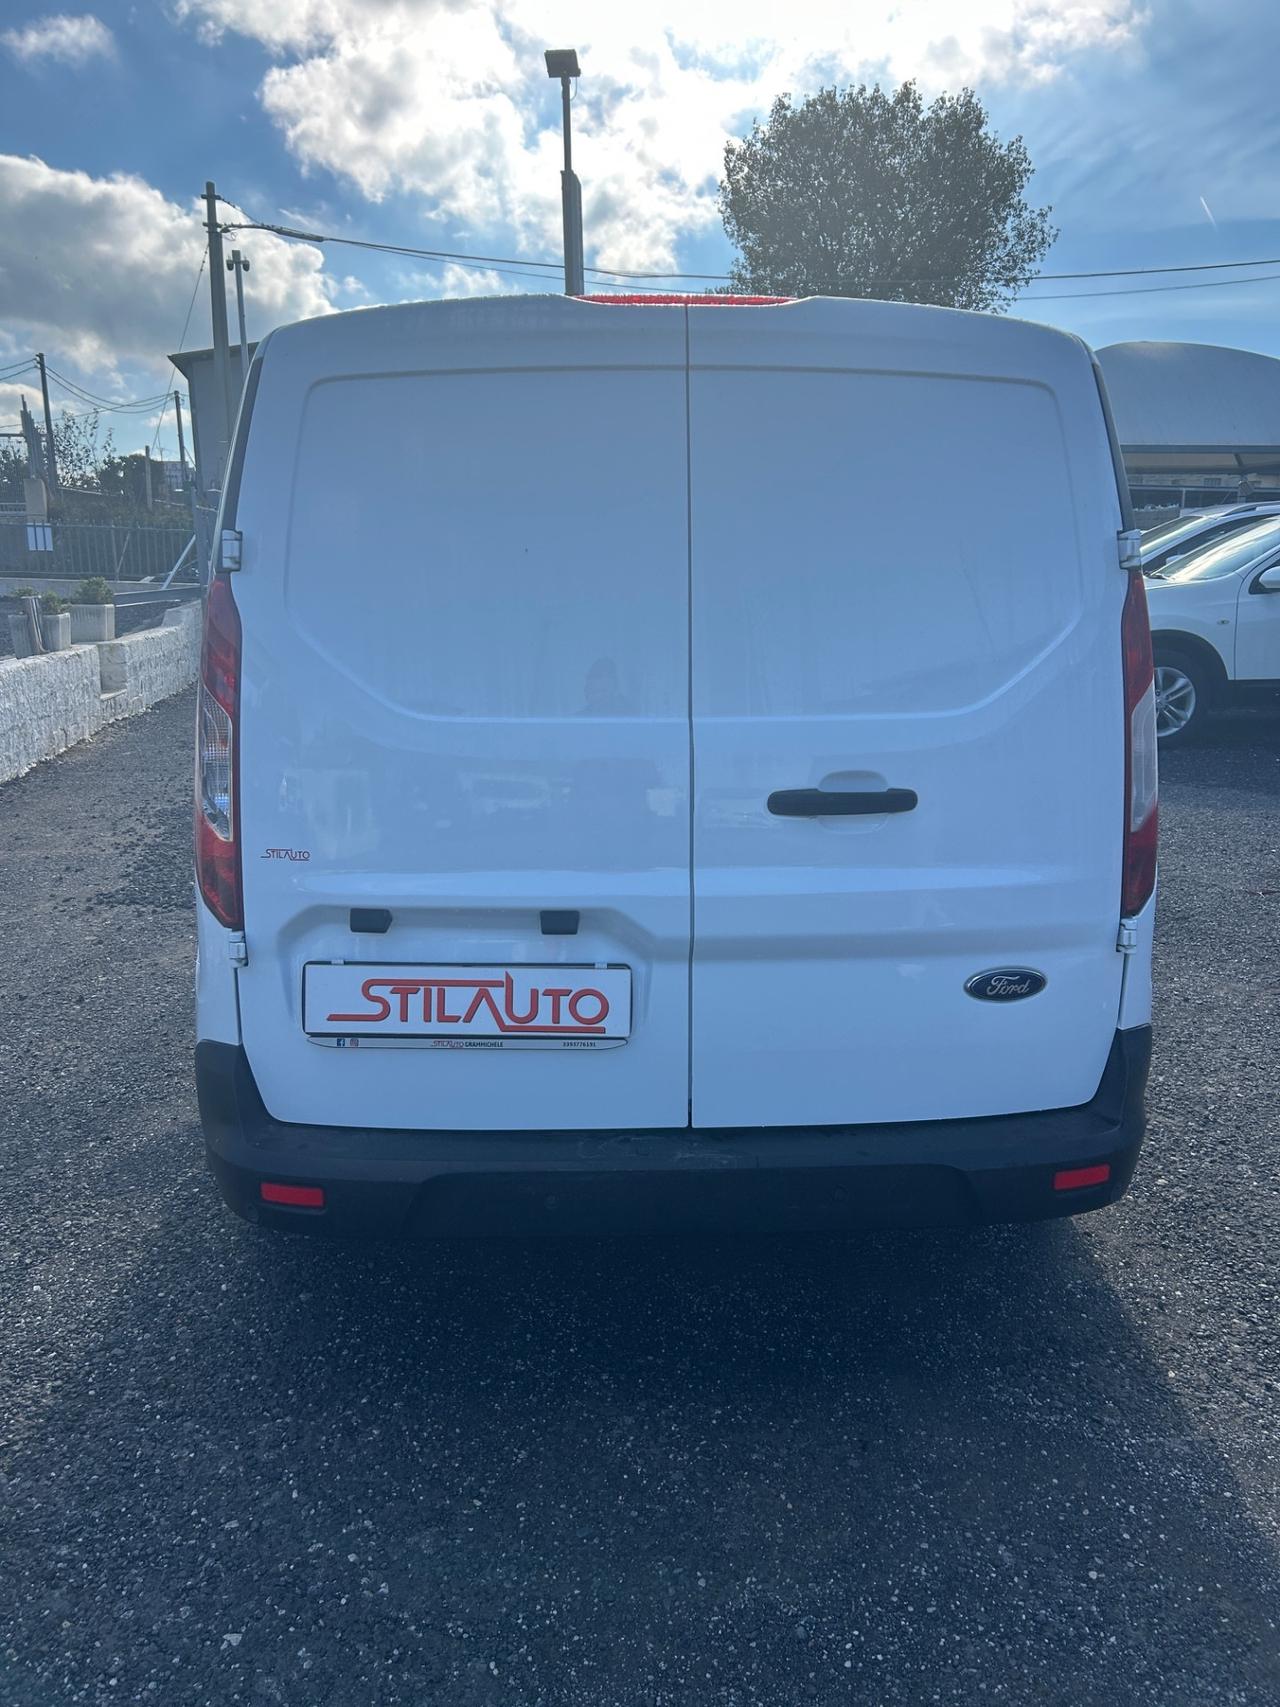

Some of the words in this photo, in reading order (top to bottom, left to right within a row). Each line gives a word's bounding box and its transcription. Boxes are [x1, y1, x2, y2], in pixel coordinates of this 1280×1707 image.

[260, 848, 310, 861] STILAUTO
[986, 975, 1031, 995] Ford
[326, 971, 609, 1033] STILAUTO
[430, 1040, 464, 1048] STILAUTO
